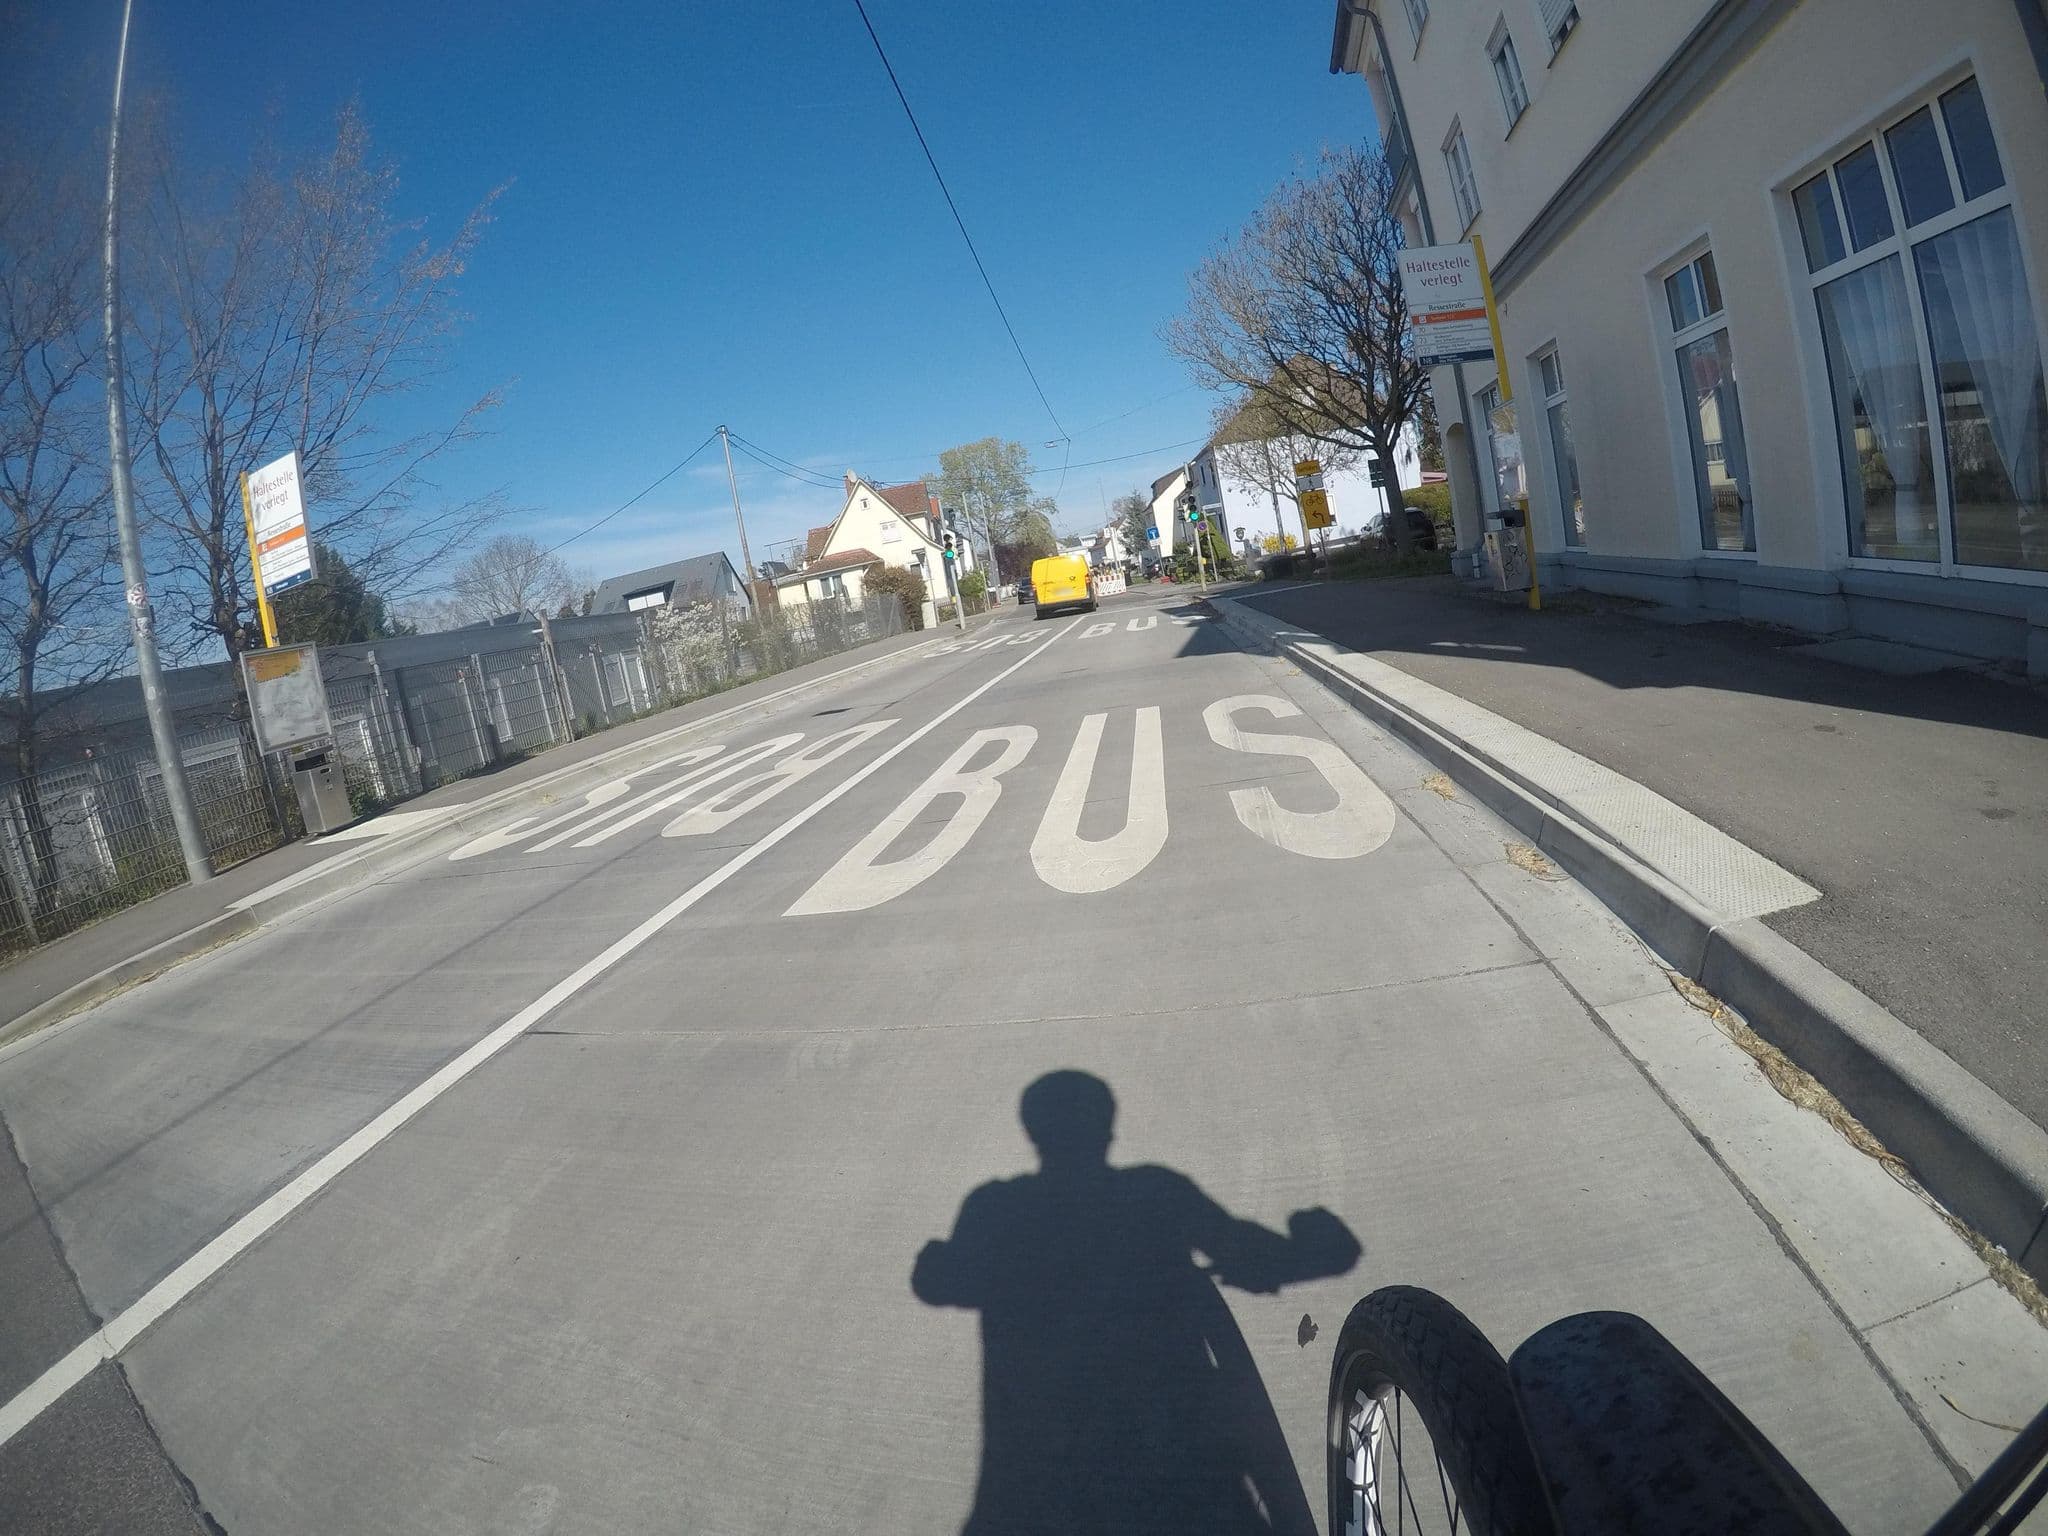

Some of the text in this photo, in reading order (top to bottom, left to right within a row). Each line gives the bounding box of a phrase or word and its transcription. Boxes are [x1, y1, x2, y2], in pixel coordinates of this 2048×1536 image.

[1406, 257, 1470, 273] Haltestelle
[1420, 273, 1464, 287] verlegt
[253, 470, 294, 499] Haltestelle
[262, 490, 289, 511] verlegt
[1078, 612, 1212, 639] BUS
[448, 719, 900, 860] BUS
[782, 694, 1396, 917] BUS
